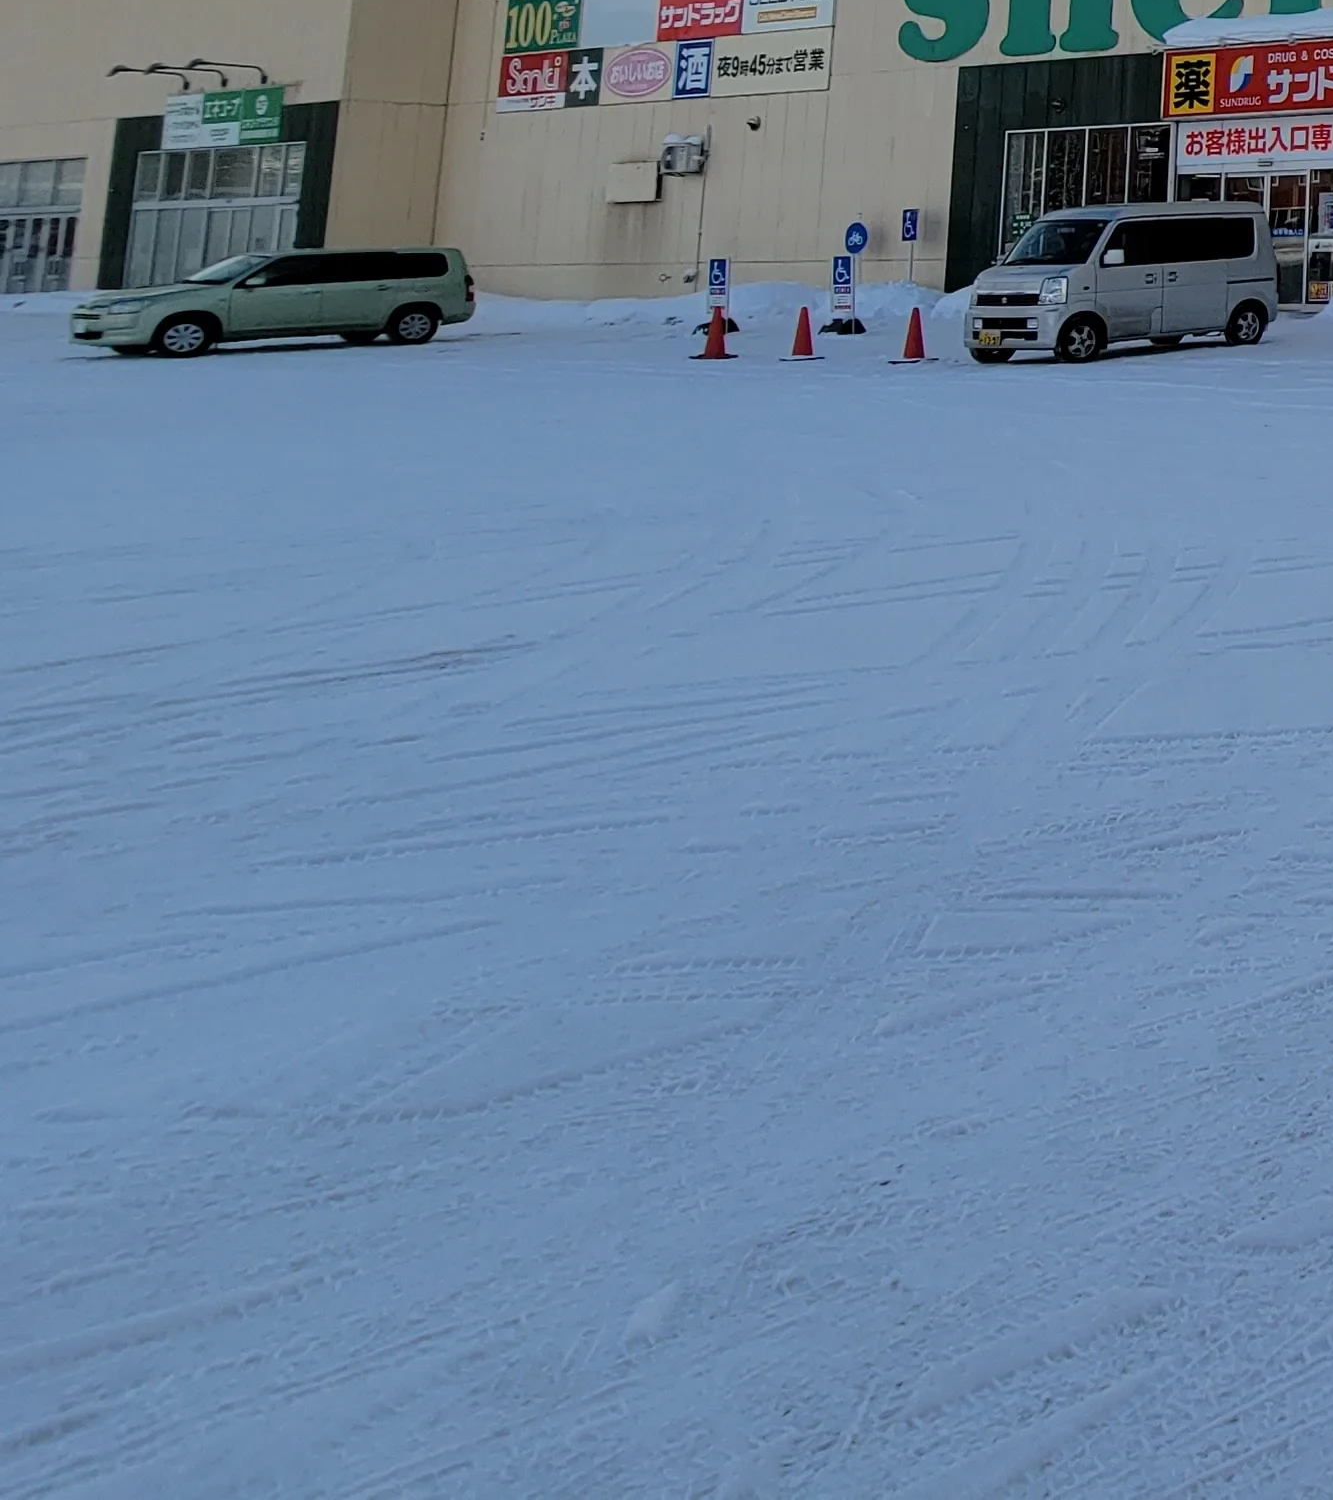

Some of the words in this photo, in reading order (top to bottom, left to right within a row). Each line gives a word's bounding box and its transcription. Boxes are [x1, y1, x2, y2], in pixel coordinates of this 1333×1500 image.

[505, 1, 552, 48] 100
[569, 55, 599, 100] 本
[678, 47, 709, 91] 酒
[1267, 51, 1297, 63] DRUG
[1301, 51, 1309, 61] &
[1173, 59, 1211, 109] 薬
[1220, 95, 1261, 108] SUNDRUG
